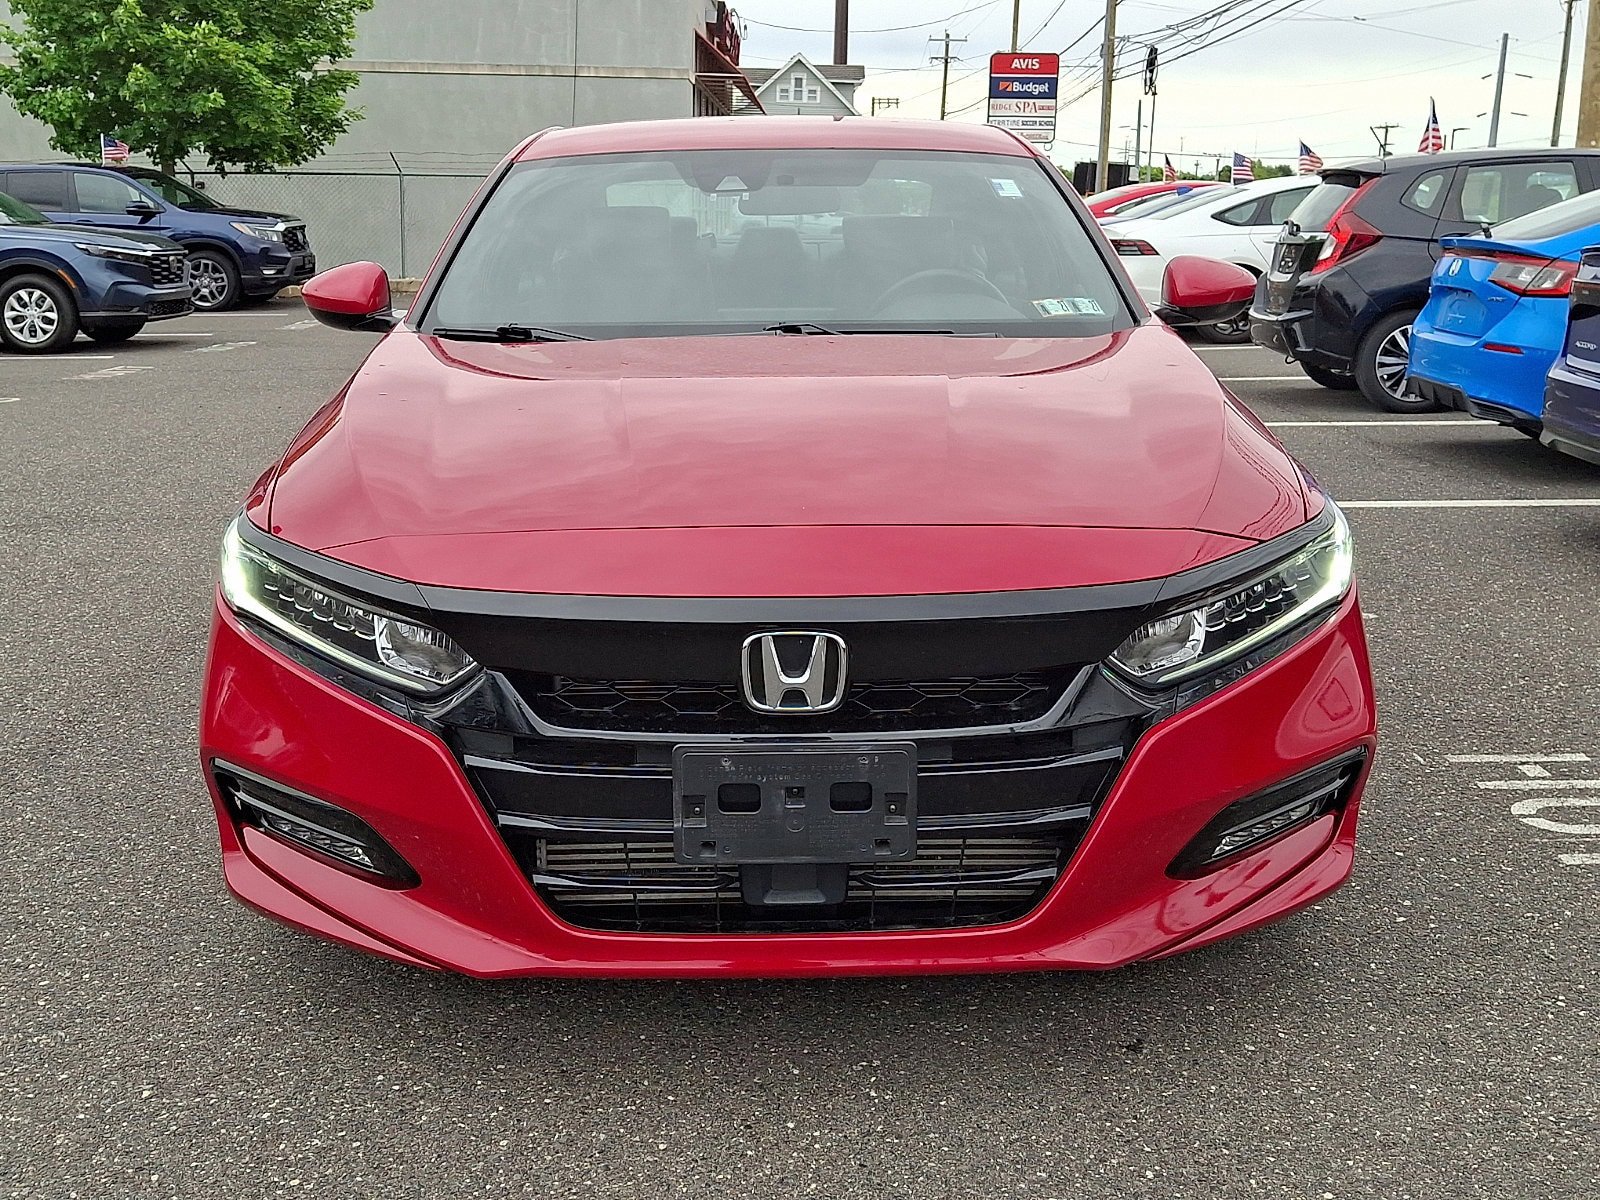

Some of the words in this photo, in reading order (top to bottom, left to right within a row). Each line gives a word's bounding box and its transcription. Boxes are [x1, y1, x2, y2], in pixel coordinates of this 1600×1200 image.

[1011, 58, 1040, 69] AVIS
[1012, 82, 1049, 95] Budget
[991, 103, 1012, 111] RIDGE
[1014, 101, 1038, 113] SPA
